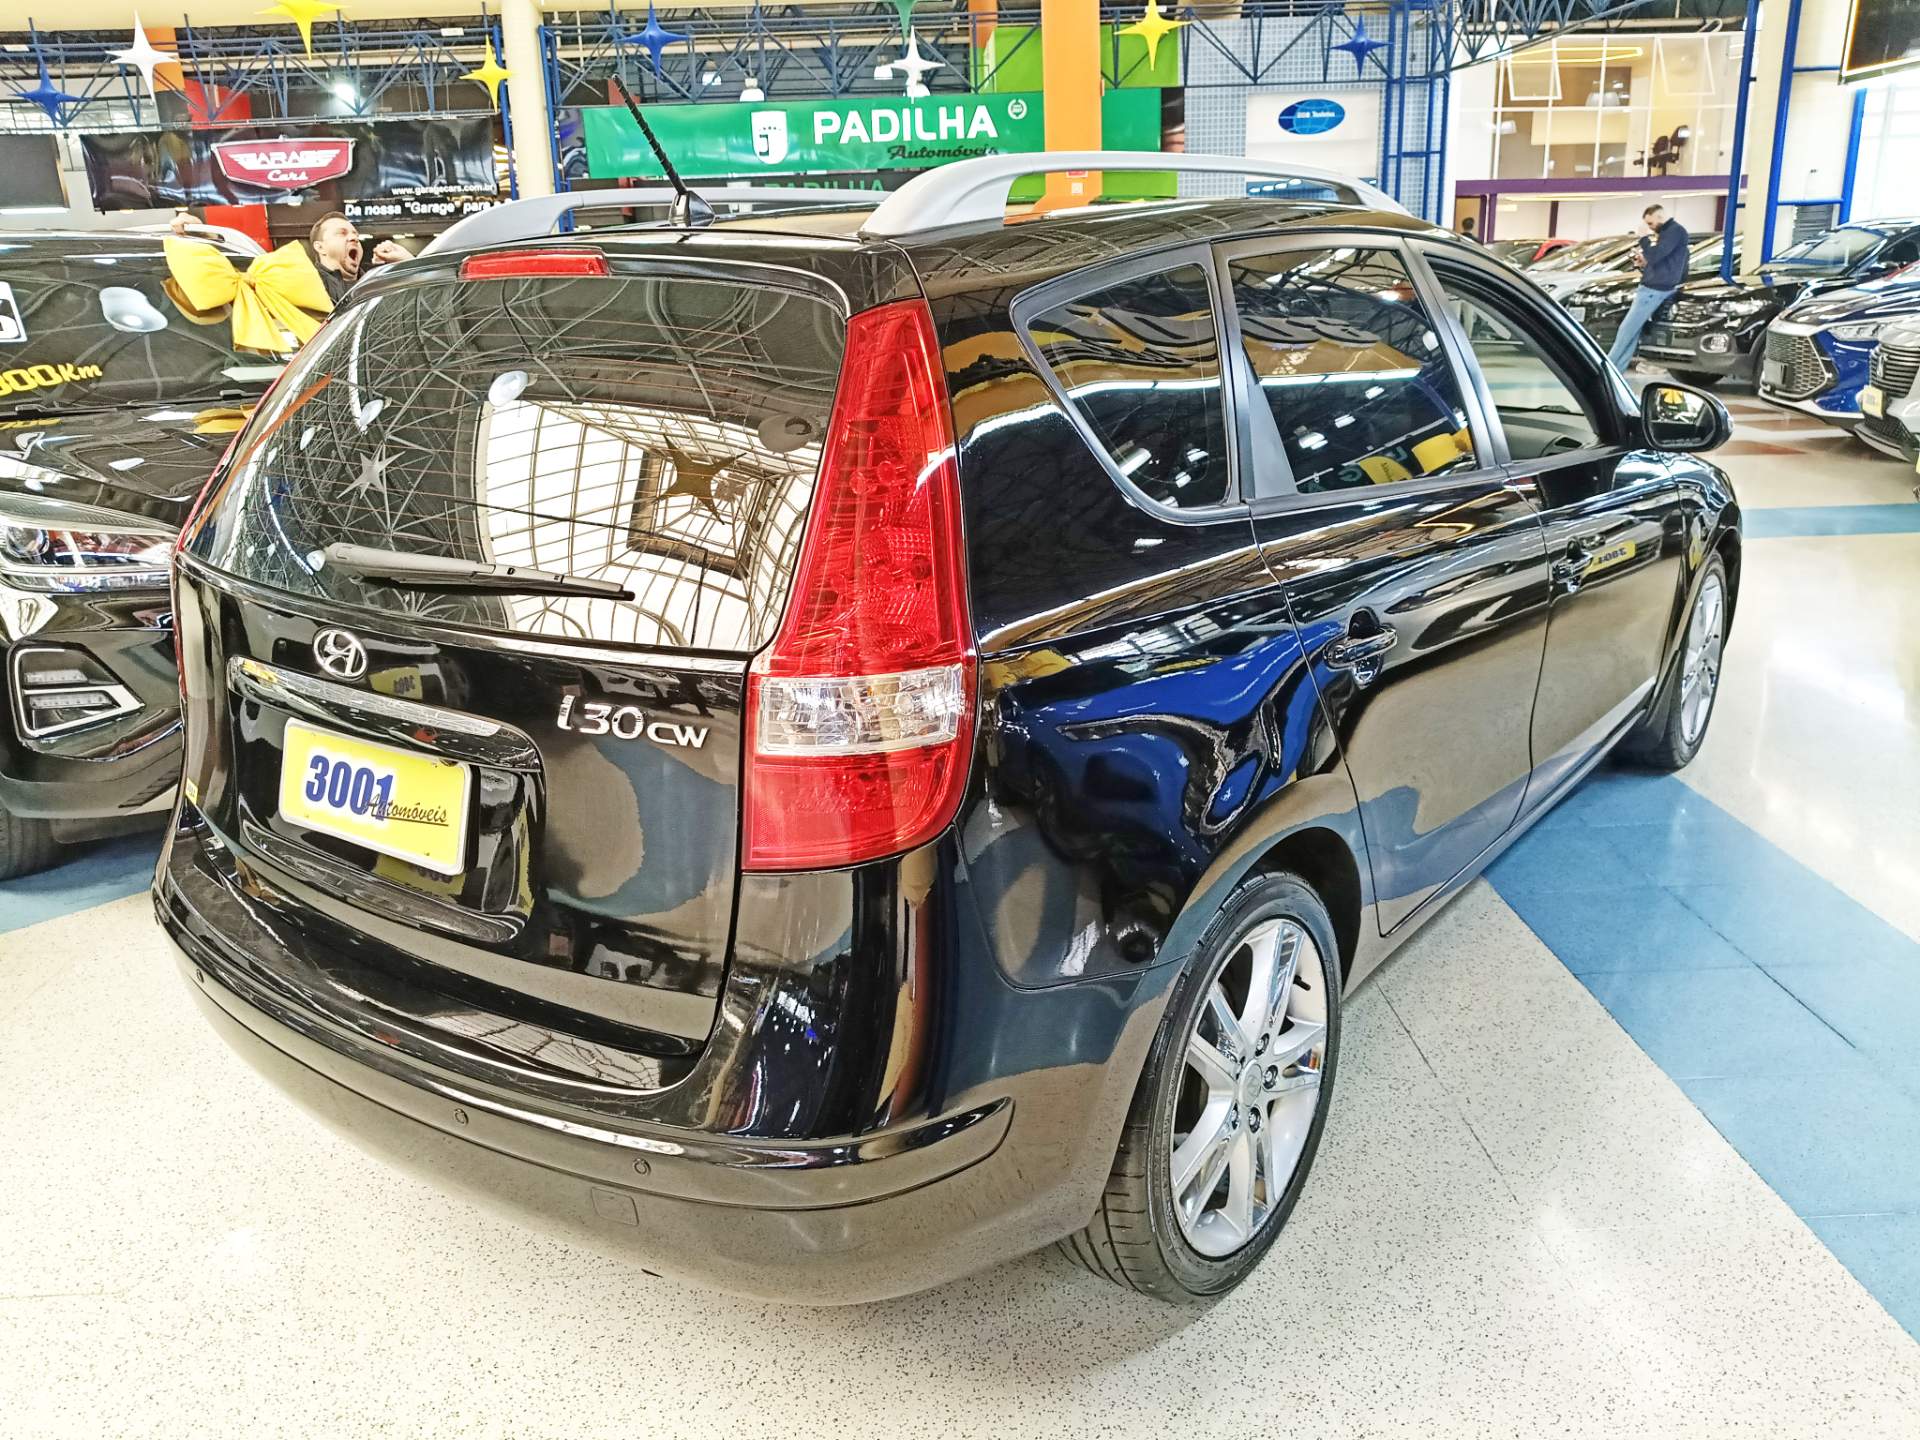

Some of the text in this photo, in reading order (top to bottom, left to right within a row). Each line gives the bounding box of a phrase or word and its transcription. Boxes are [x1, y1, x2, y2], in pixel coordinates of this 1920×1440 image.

[812, 104, 999, 145] PADILHA
[267, 169, 308, 181] Cars
[344, 204, 361, 217] Da
[364, 204, 401, 216] nossa
[305, 754, 394, 821] 3001
[364, 794, 448, 824] Automóveis
